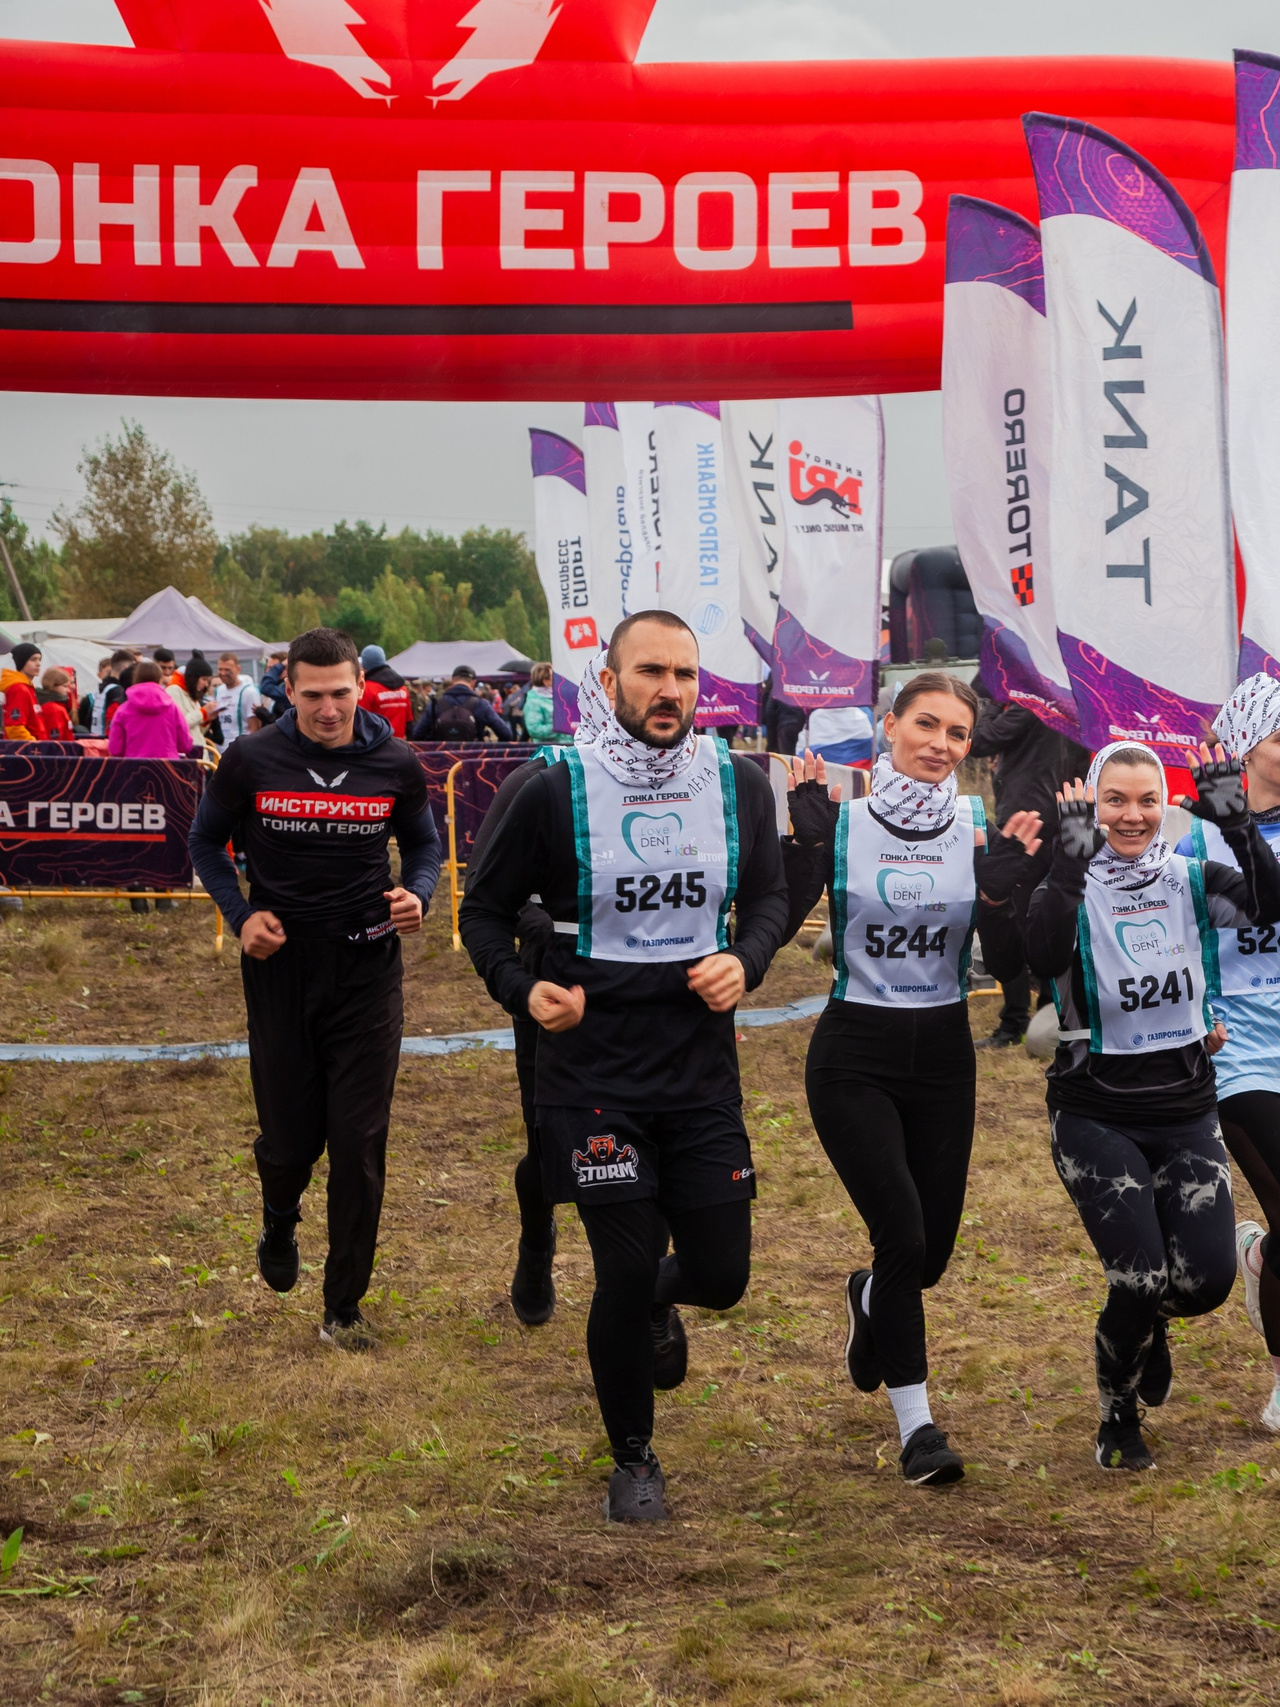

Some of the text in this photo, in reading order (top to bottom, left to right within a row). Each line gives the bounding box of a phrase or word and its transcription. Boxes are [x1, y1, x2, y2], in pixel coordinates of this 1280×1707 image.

[416, 169, 926, 271] ГЕРОЕВ
[623, 791, 690, 803] ГОНКА ГЕРОЕВ
[260, 796, 391, 818] ИНСТРУКТОР
[28, 801, 166, 830] ГЕРОЕВ
[262, 818, 385, 836] ГОНКА ГЕРОЕВ
[640, 826, 670, 836] Love
[640, 836, 671, 848] DENT
[674, 843, 698, 857] kids
[880, 853, 943, 862] ГОНКА ГЕРОЕВ
[615, 871, 706, 913] 5245
[893, 891, 922, 901] DENT
[924, 901, 947, 912] kids
[1112, 900, 1167, 913] ГОНКА ГЕРОЕВ
[642, 935, 695, 948] ГАЗПРОМБАНК
[865, 924, 949, 959] 5244
[1132, 939, 1160, 953] DENT
[1163, 943, 1185, 957] kids
[890, 983, 939, 993] ГАЗПРОМБАНК
[1118, 967, 1194, 1013] 5241
[1147, 1027, 1193, 1042] ГАЗПРОМБАНК
[579, 1162, 636, 1183] STORM
